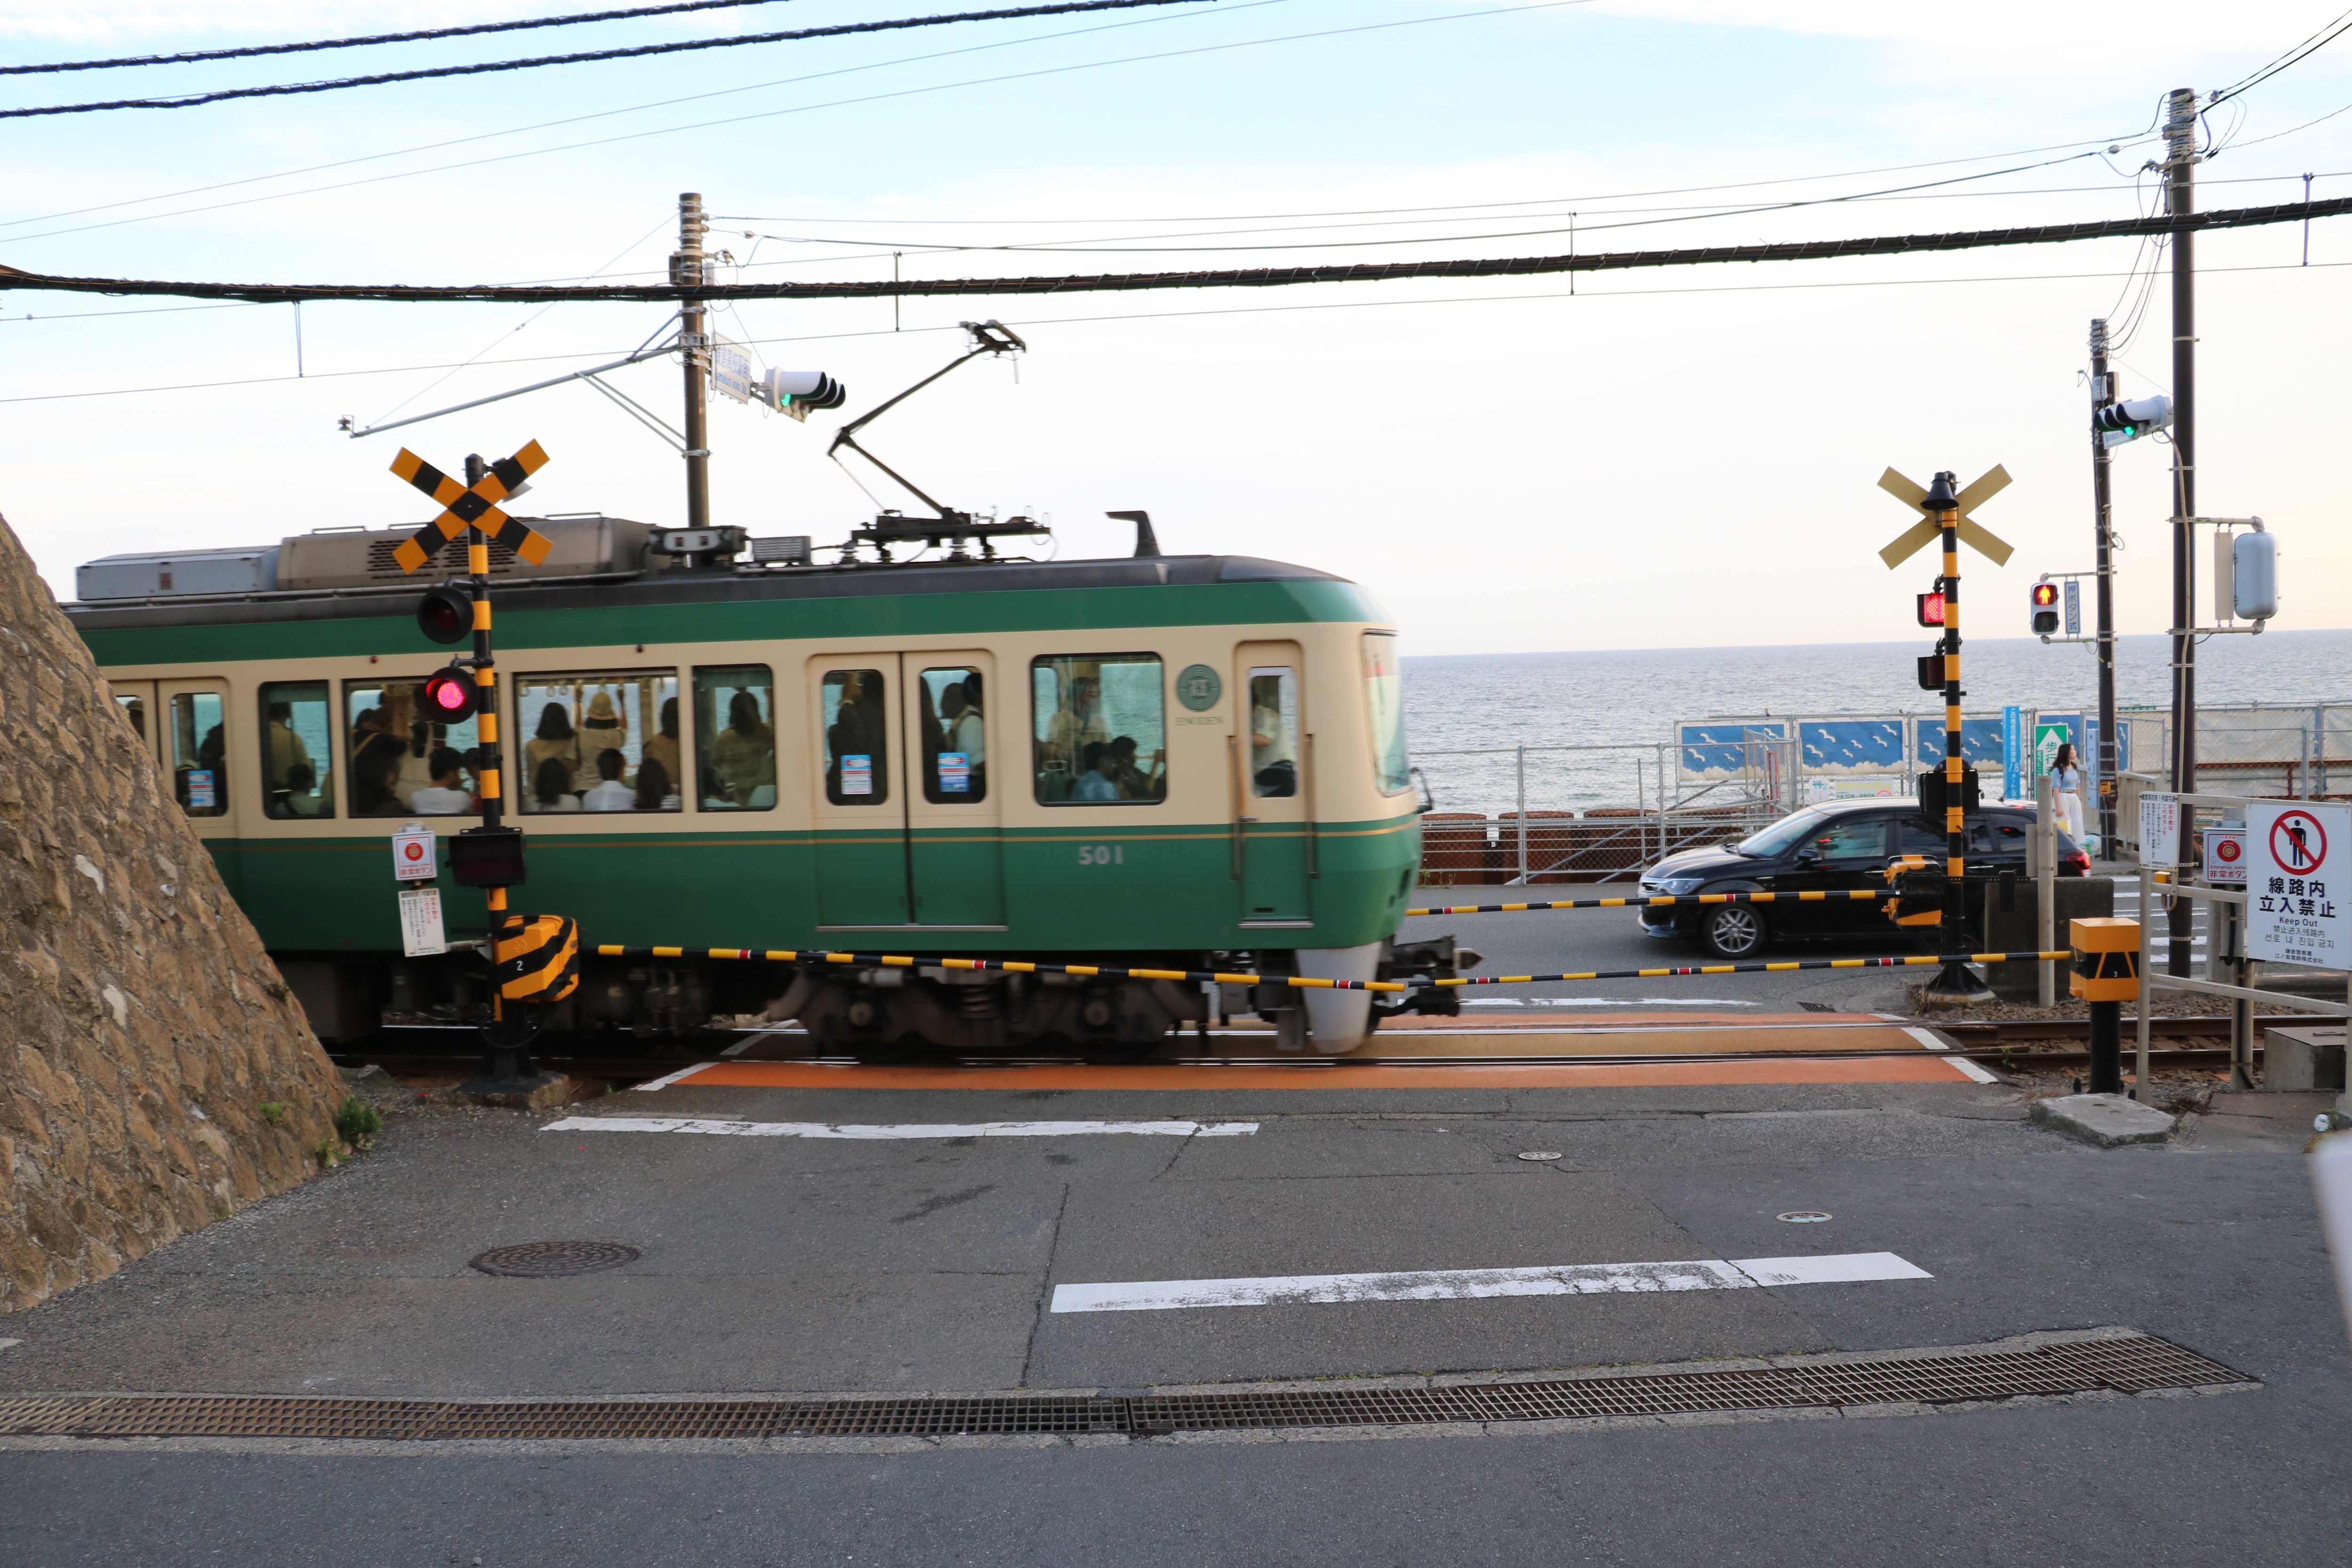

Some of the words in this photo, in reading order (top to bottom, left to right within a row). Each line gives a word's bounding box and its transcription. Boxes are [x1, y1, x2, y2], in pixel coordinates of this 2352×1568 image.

[716, 372, 731, 387] amakura
[2068, 585, 2077, 630] 押ボタン式
[1079, 845, 1123, 865] 501
[400, 867, 430, 876] 非常ボタン
[2209, 870, 2247, 879] 非常ボタン
[2269, 876, 2325, 898] 線路内
[2259, 895, 2336, 918] 立入禁止
[2279, 916, 2300, 926] Keep
[2303, 918, 2318, 927] Out
[2273, 925, 2325, 938] 禁止进入线路内
[2265, 933, 2280, 943] 선로
[2286, 936, 2293, 944] 내
[2299, 937, 2314, 947] 진입
[2318, 939, 2334, 949] 금지
[2274, 953, 2323, 964] 江ノ島電鉄株式会社
[2285, 948, 2312, 957] 鎌倉警察署
[516, 960, 524, 971] 2
